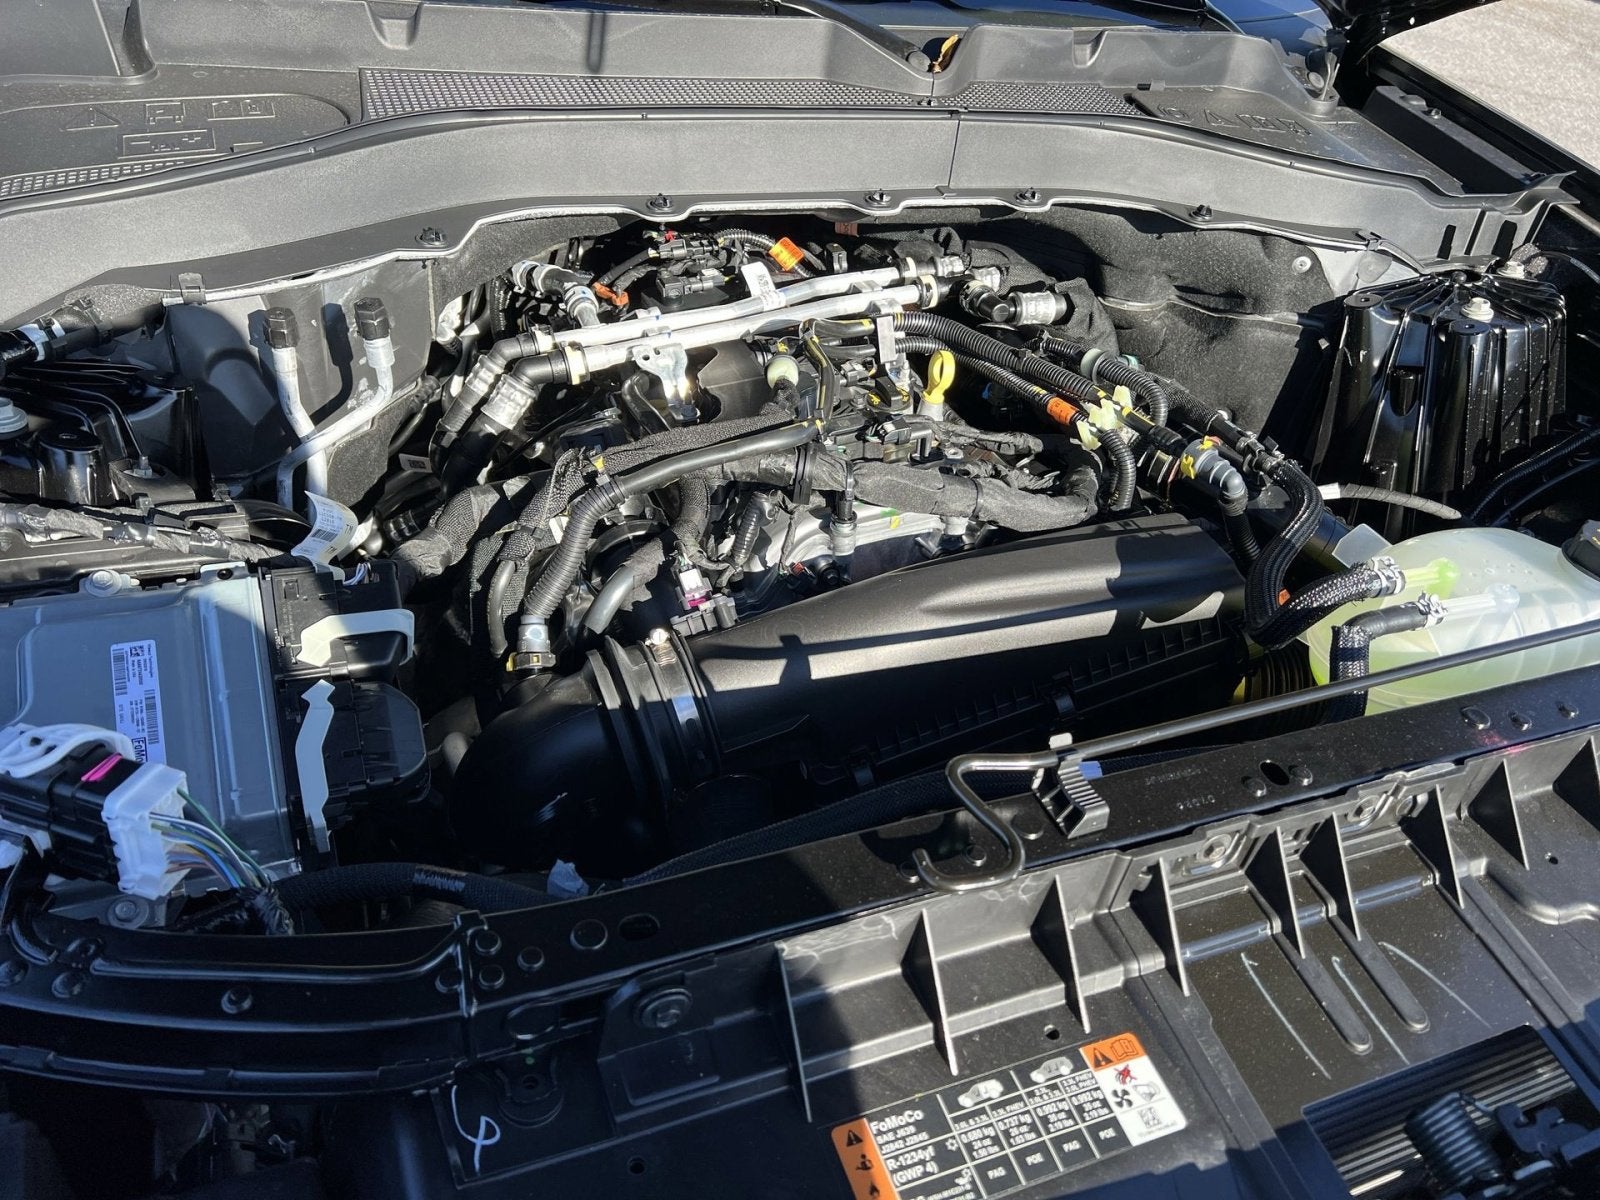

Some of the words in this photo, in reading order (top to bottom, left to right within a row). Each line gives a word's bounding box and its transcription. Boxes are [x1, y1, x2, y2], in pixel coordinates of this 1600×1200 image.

[134, 739, 146, 763] FoMo
[1091, 1088, 1105, 1101] kg
[1056, 1099, 1070, 1112] kg
[869, 1110, 925, 1134] FoMoCo
[997, 1116, 1020, 1131] 0.737
[1019, 1112, 1033, 1126] kg
[876, 1131, 896, 1144] SAE
[983, 1124, 996, 1138] kg
[1062, 1140, 1081, 1152] PAG
[886, 1145, 936, 1170] R-1234yf
[893, 1164, 925, 1187] (GWP
[925, 1160, 940, 1174] 4)
[987, 1167, 1006, 1179] PAG
